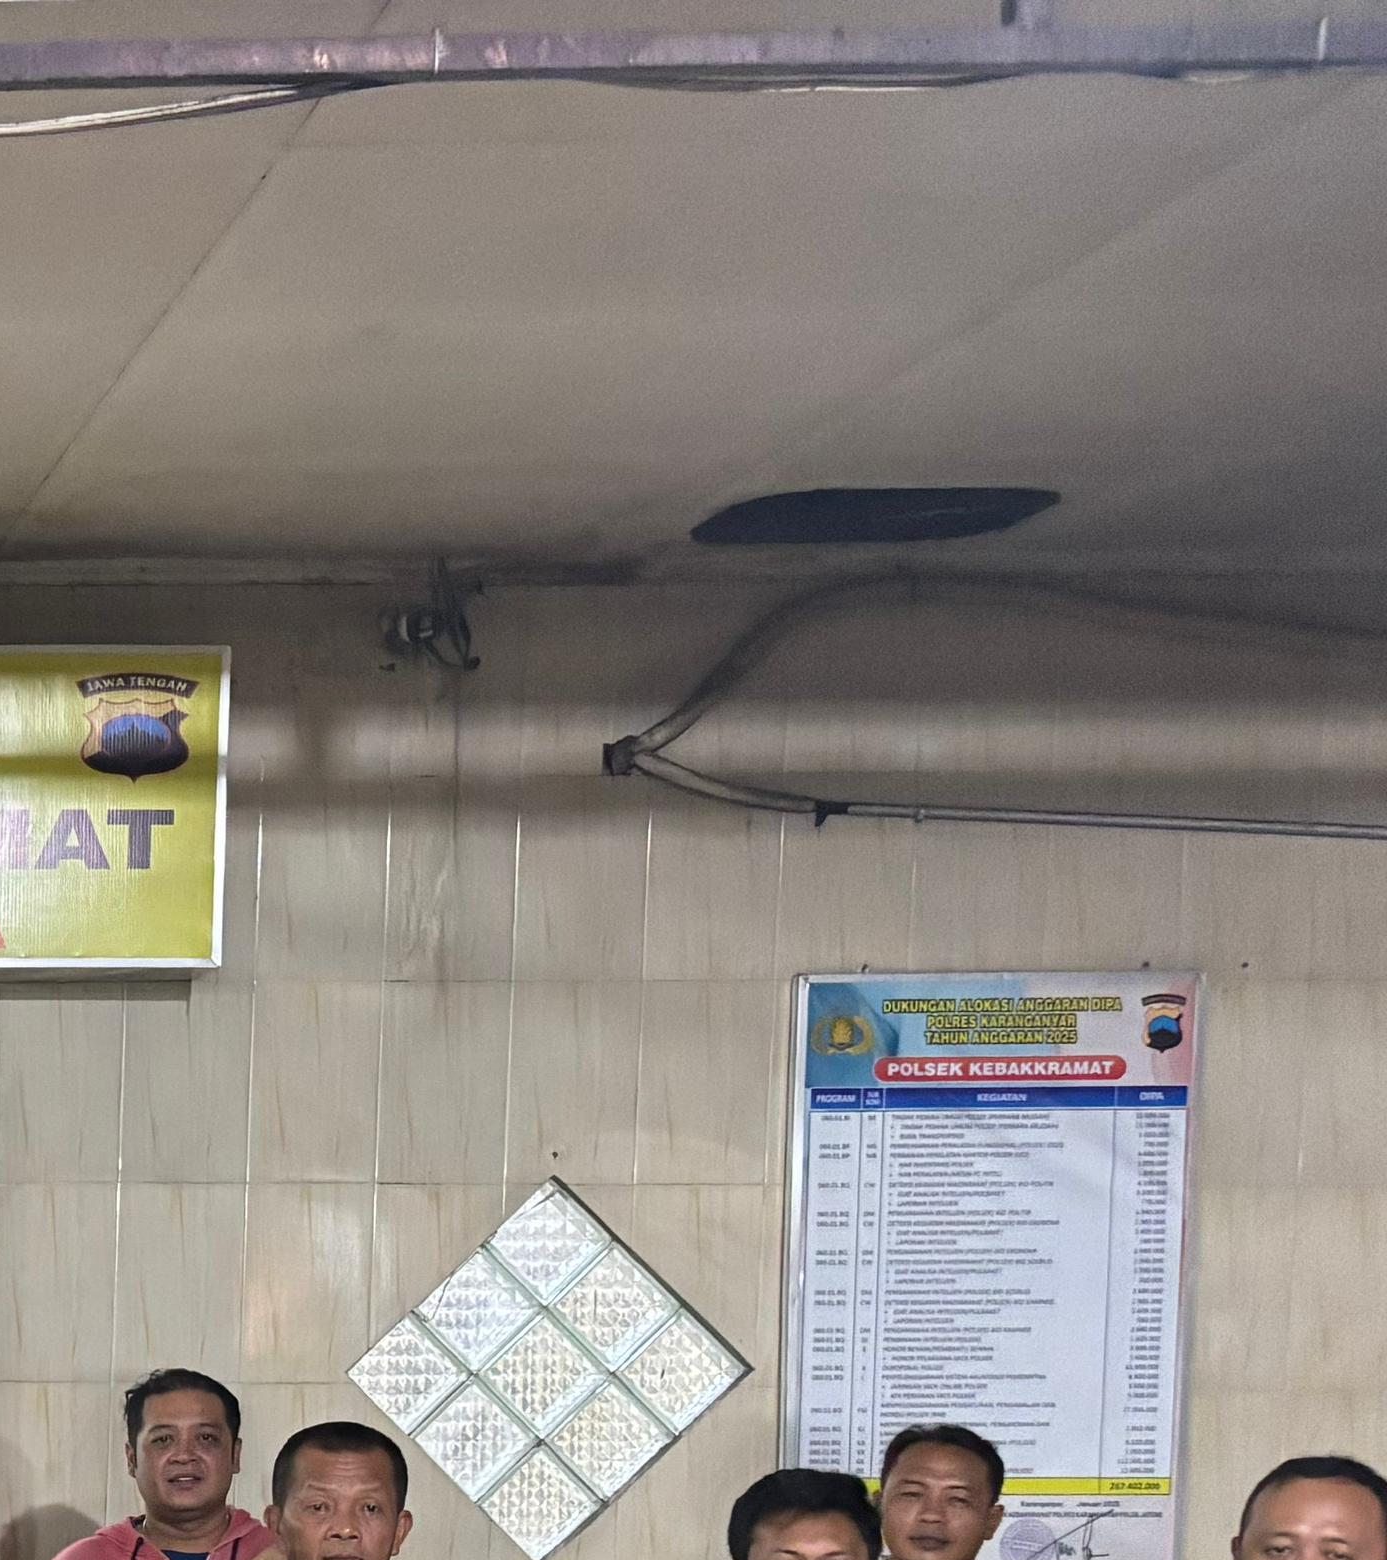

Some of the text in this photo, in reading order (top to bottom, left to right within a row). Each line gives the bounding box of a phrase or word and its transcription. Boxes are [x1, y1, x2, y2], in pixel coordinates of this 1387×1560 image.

[87, 676, 187, 692] JAWA TENGAH
[882, 997, 1123, 1013] DUKUNGAN ALOKASI ANGGARAN DIPA
[927, 1014, 1077, 1029] POLRES KARANGANYAR
[925, 1030, 1077, 1045] TAHUN ANGGARAN 2025
[887, 1060, 1114, 1076] POLSEK KEBAKKRAMAT
